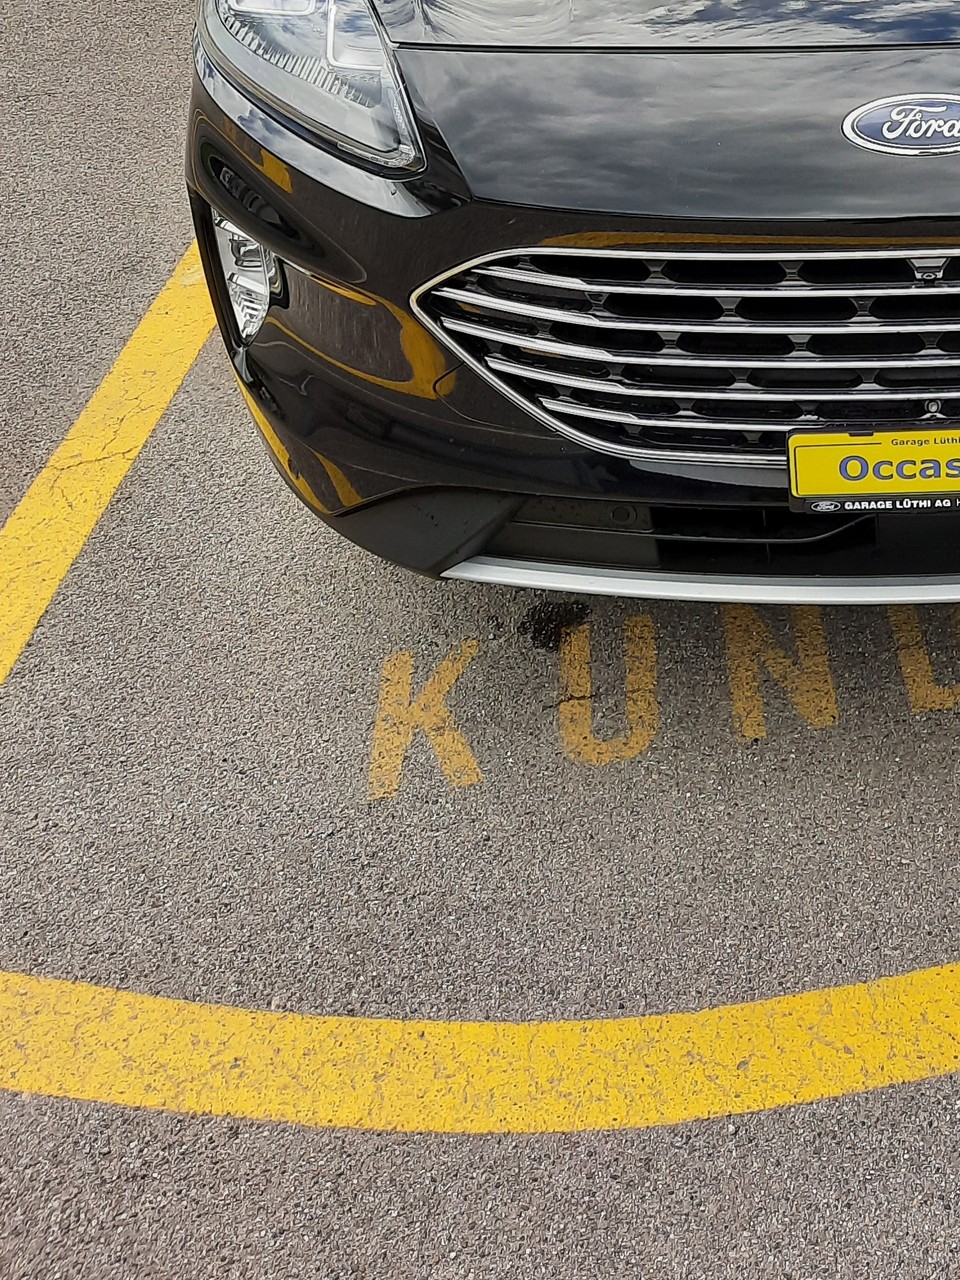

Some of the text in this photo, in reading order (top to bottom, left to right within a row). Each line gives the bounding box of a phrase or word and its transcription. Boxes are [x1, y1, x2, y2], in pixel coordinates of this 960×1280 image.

[891, 437, 930, 447] Garage
[933, 435, 960, 445] Lüthi
[813, 502, 839, 511] Ford
[844, 501, 893, 510] GARAGE
[896, 498, 931, 509] LÜTHI
[934, 499, 951, 508] AG
